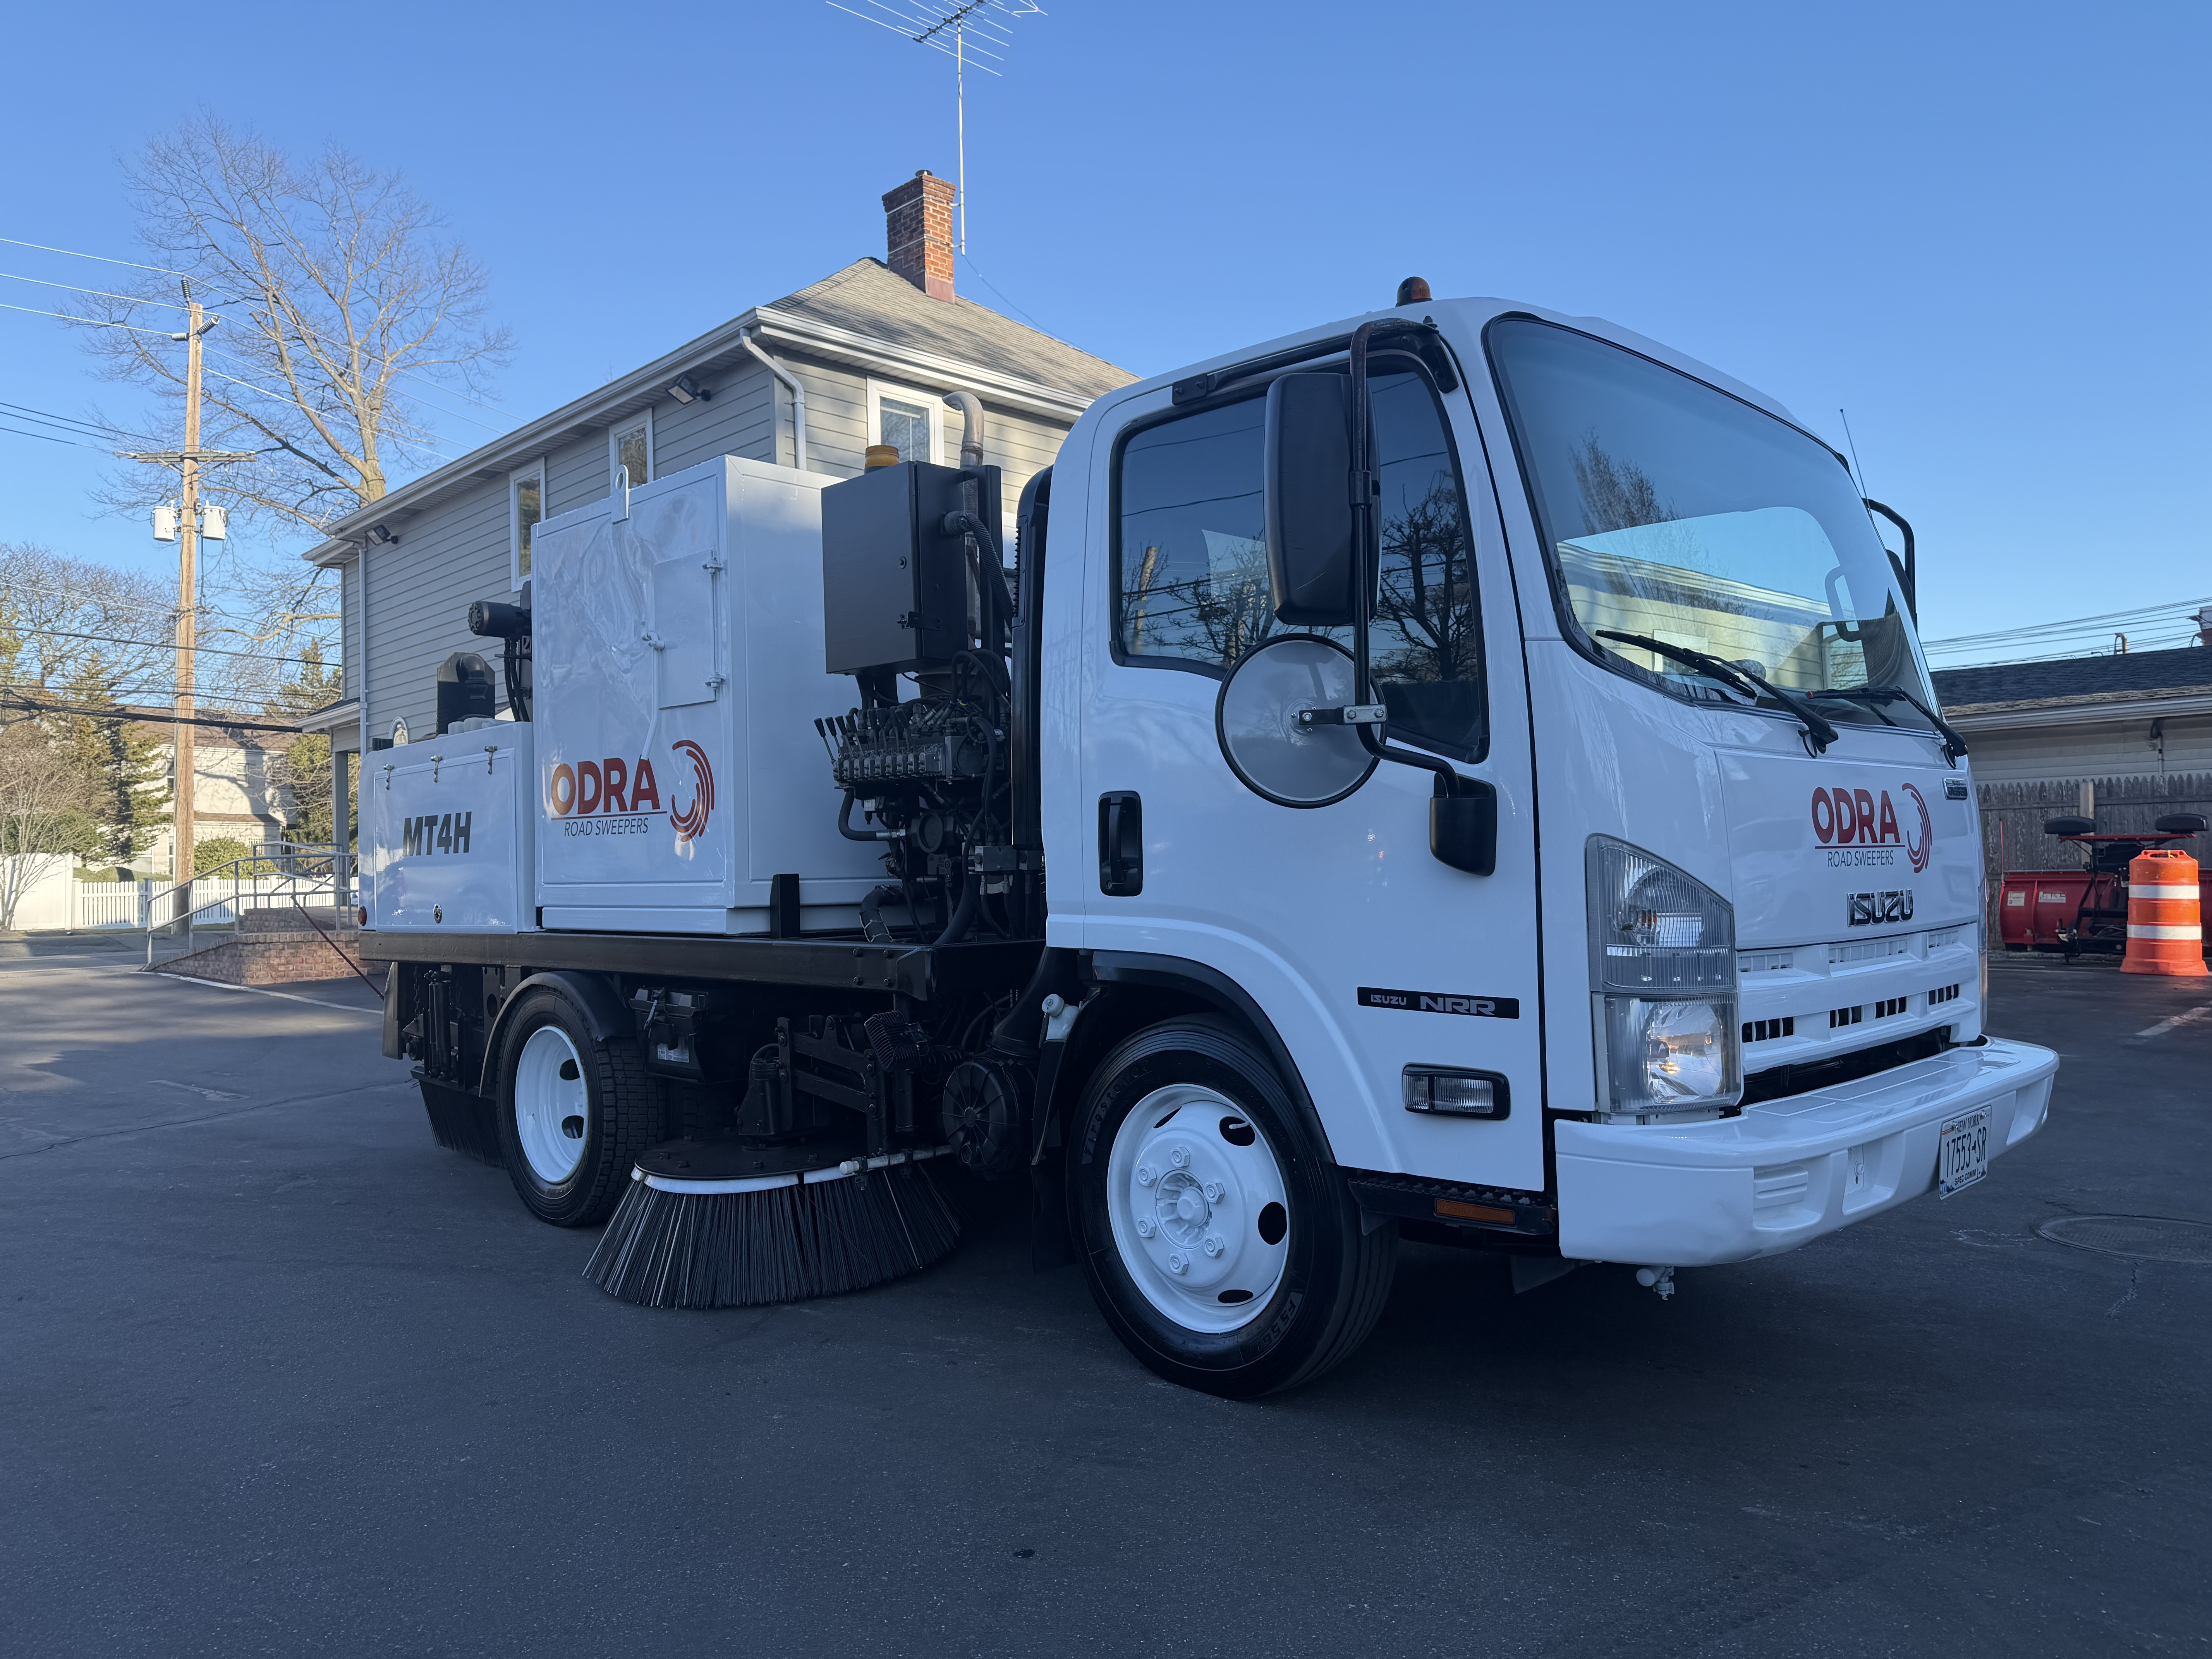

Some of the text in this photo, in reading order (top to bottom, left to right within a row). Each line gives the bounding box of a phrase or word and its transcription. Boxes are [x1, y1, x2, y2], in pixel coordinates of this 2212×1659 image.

[551, 757, 661, 816] ODRA
[1812, 787, 1900, 844] ODRA
[402, 812, 471, 856] MT4H
[564, 818, 649, 837] ROAD SWEEPERS
[1828, 850, 1894, 867] ROAD SWEEPERS
[1846, 888, 1913, 927] ISUZU
[1370, 994, 1496, 1015] ISUZU NRR
[1955, 1114, 1980, 1134] NEW YORK
[1955, 1169, 1977, 1185] SPEC-COMM
